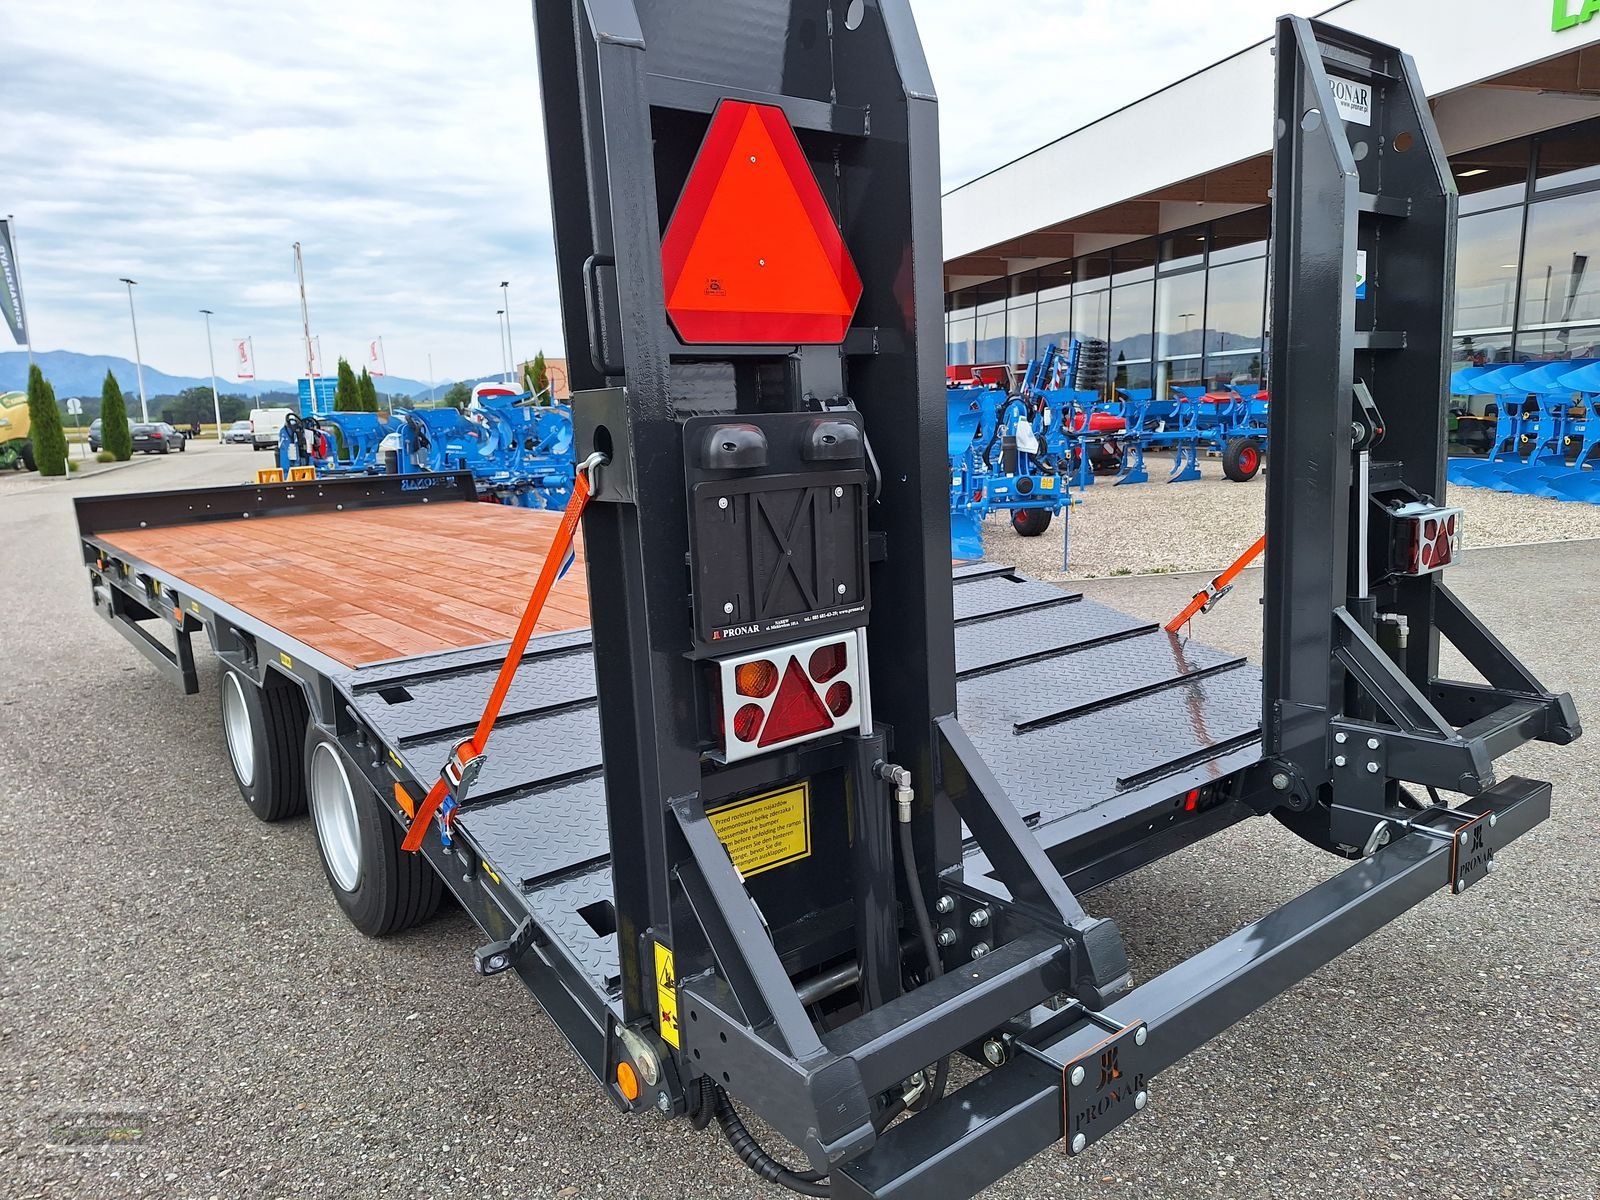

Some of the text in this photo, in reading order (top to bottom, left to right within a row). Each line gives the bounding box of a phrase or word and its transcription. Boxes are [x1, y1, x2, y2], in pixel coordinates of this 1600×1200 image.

[1329, 80, 1368, 107] RONAR
[723, 624, 760, 638] PRONAR
[769, 806, 791, 818] zderzaka
[715, 816, 731, 825] Przed
[749, 824, 758, 832] the
[759, 818, 779, 829] bumper
[734, 834, 751, 845] before
[752, 827, 776, 839] unfolding
[776, 823, 785, 831] the
[786, 819, 802, 828] ramps
[753, 839, 762, 847] Sie
[762, 836, 772, 845] den
[772, 829, 794, 841] hinteren
[749, 847, 764, 856] bevor
[765, 843, 773, 851] Sie
[759, 846, 787, 859] ausklappen
[1459, 848, 1493, 878] PRONAR
[1075, 1073, 1144, 1131] PRONAR
